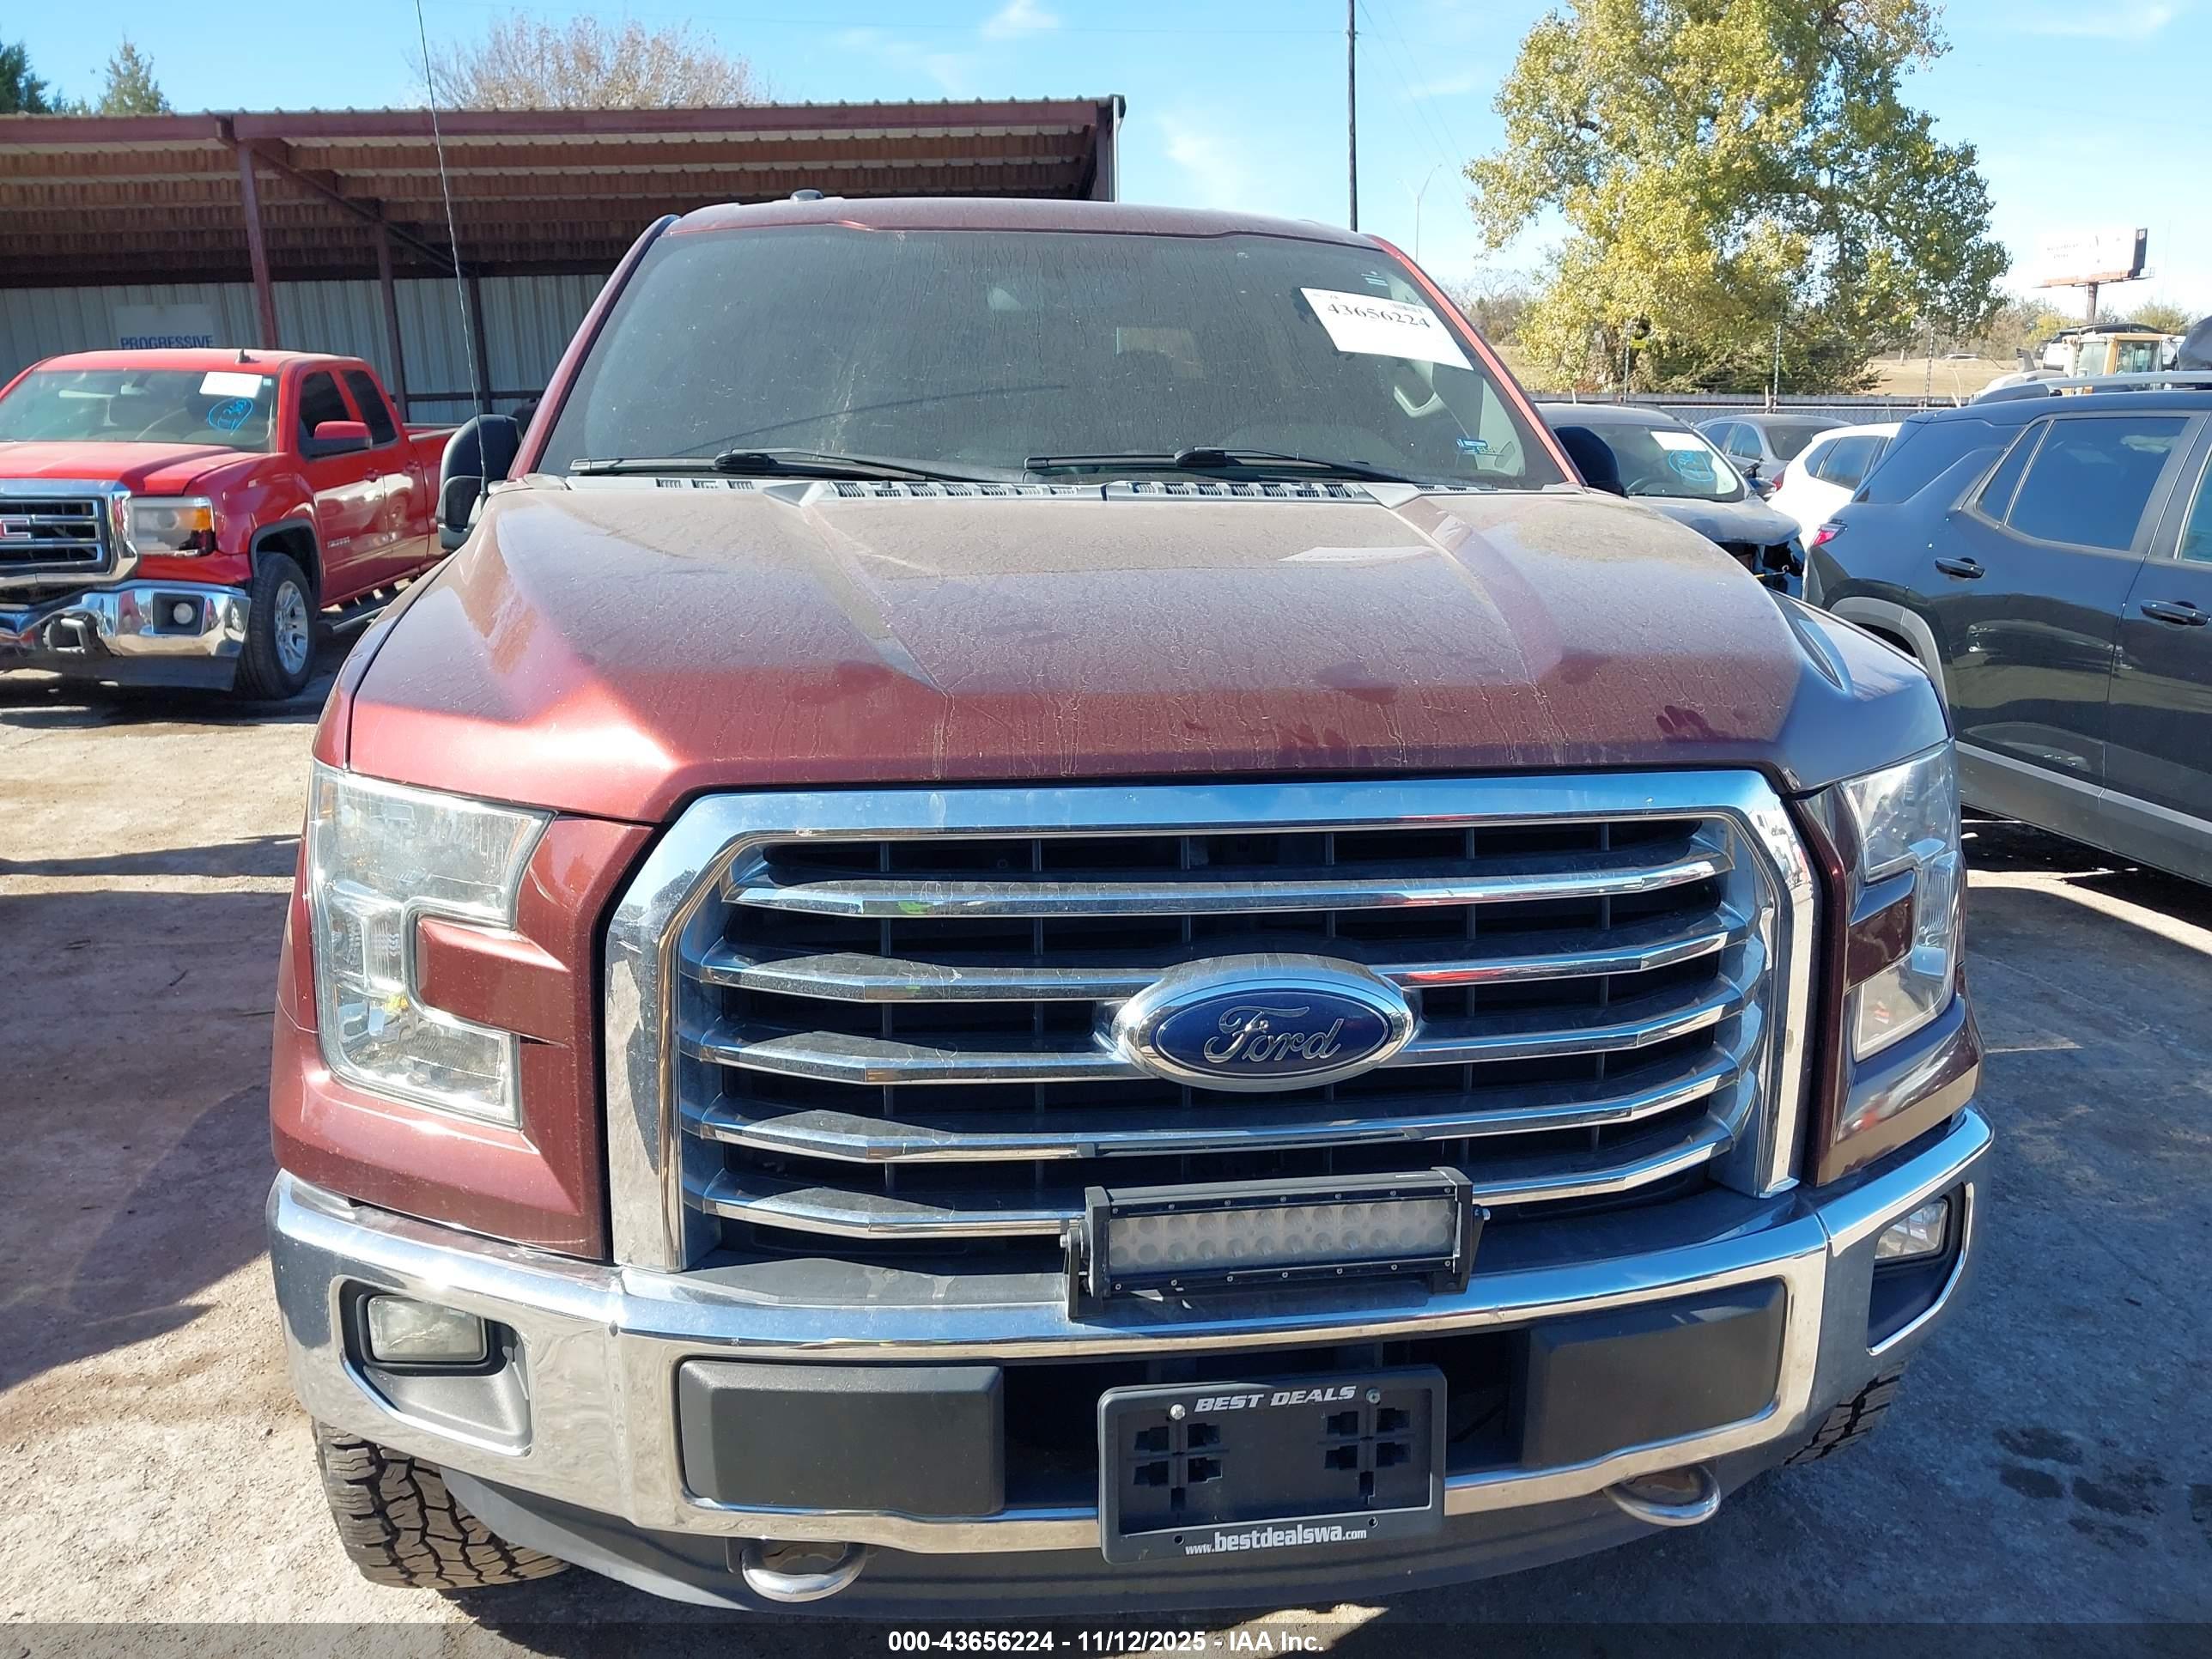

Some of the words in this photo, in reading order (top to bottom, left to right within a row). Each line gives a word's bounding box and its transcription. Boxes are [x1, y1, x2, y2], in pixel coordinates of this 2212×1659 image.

[1328, 303, 1431, 328] 43656224
[120, 335, 213, 349] PROGRESSIVE
[1203, 1006, 1344, 1063] Ford
[1194, 1394, 1265, 1413] BEST
[1270, 1386, 1357, 1407] DEALS
[1185, 1524, 1367, 1555] www.bestdealswa.com
